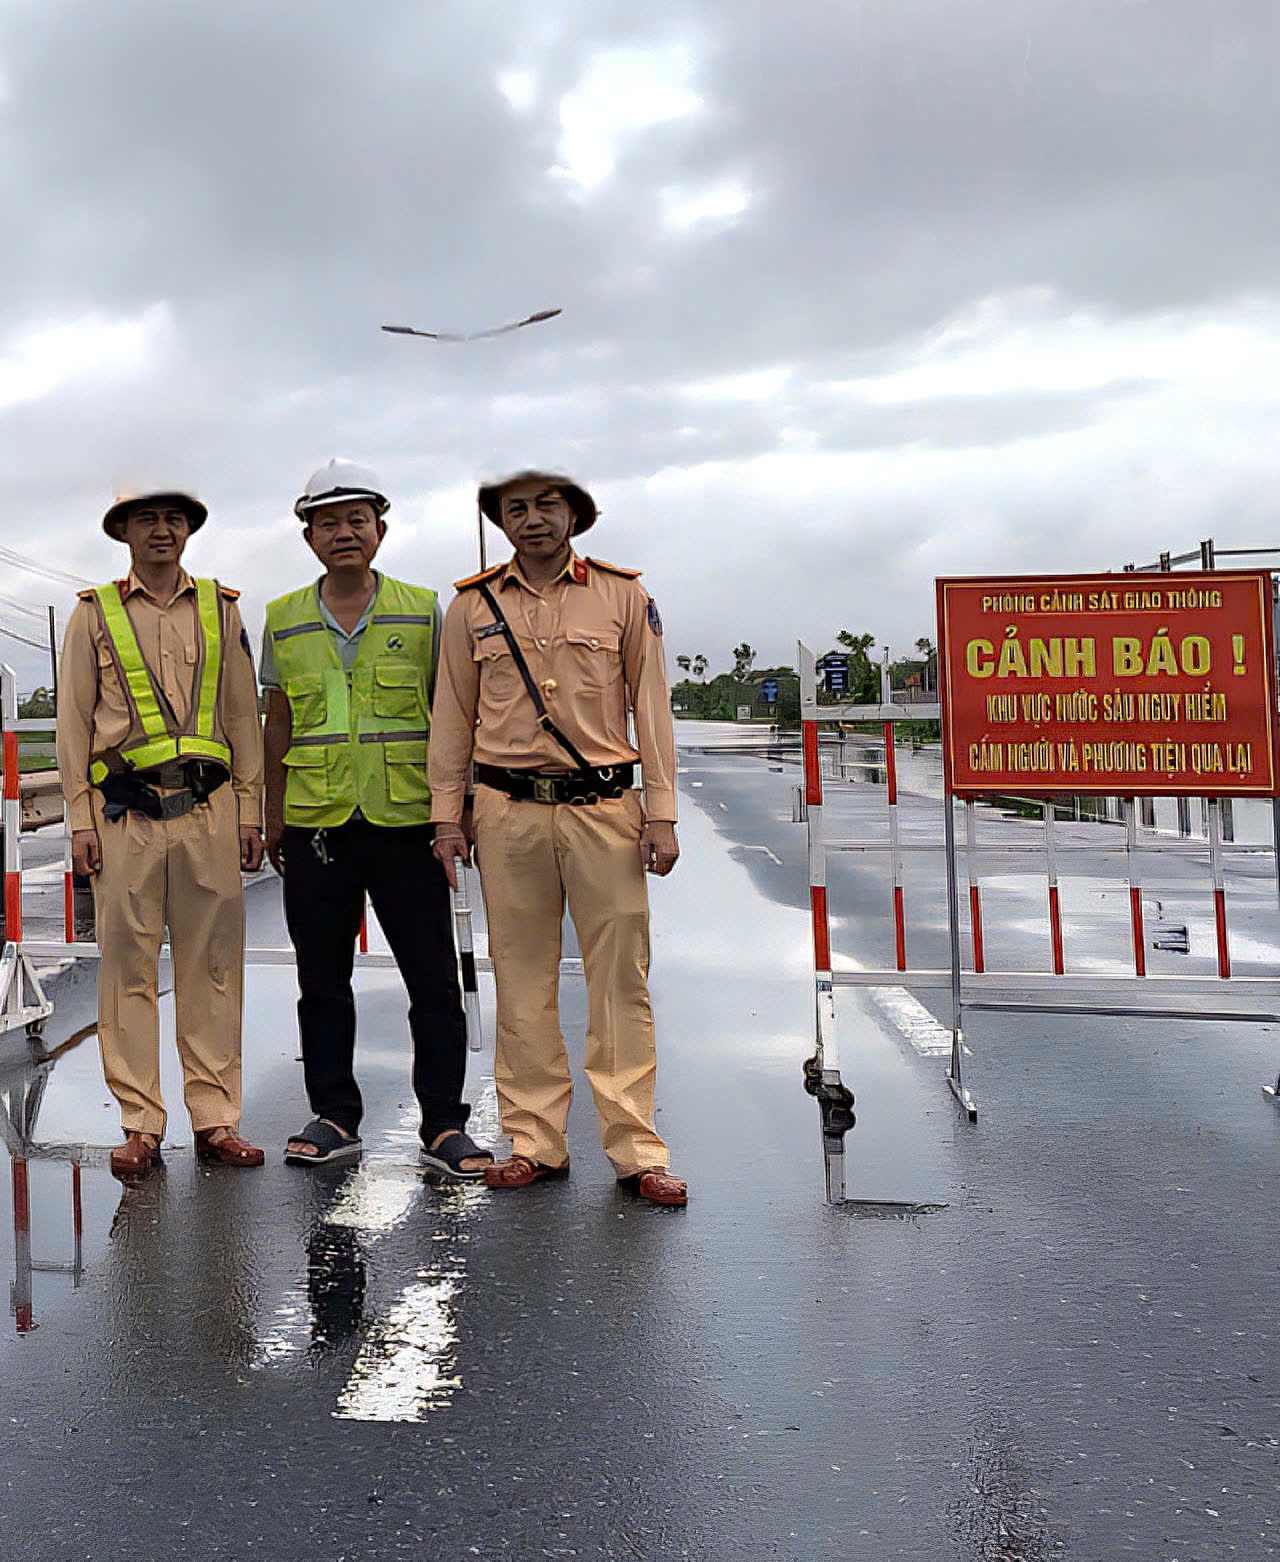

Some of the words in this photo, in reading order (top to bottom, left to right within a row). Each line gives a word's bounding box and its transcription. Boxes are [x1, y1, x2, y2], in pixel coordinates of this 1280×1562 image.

[1040, 588, 1083, 612] CẢNH
[1125, 591, 1161, 610] GIAO
[1167, 587, 1223, 609] THÔNG
[966, 624, 1096, 678] CẢNH
[1112, 626, 1211, 677] BÁO
[1231, 634, 1247, 676] !
[986, 694, 1018, 723] KHU
[1138, 693, 1180, 722] NGUY
[1192, 743, 1224, 774] QUA
